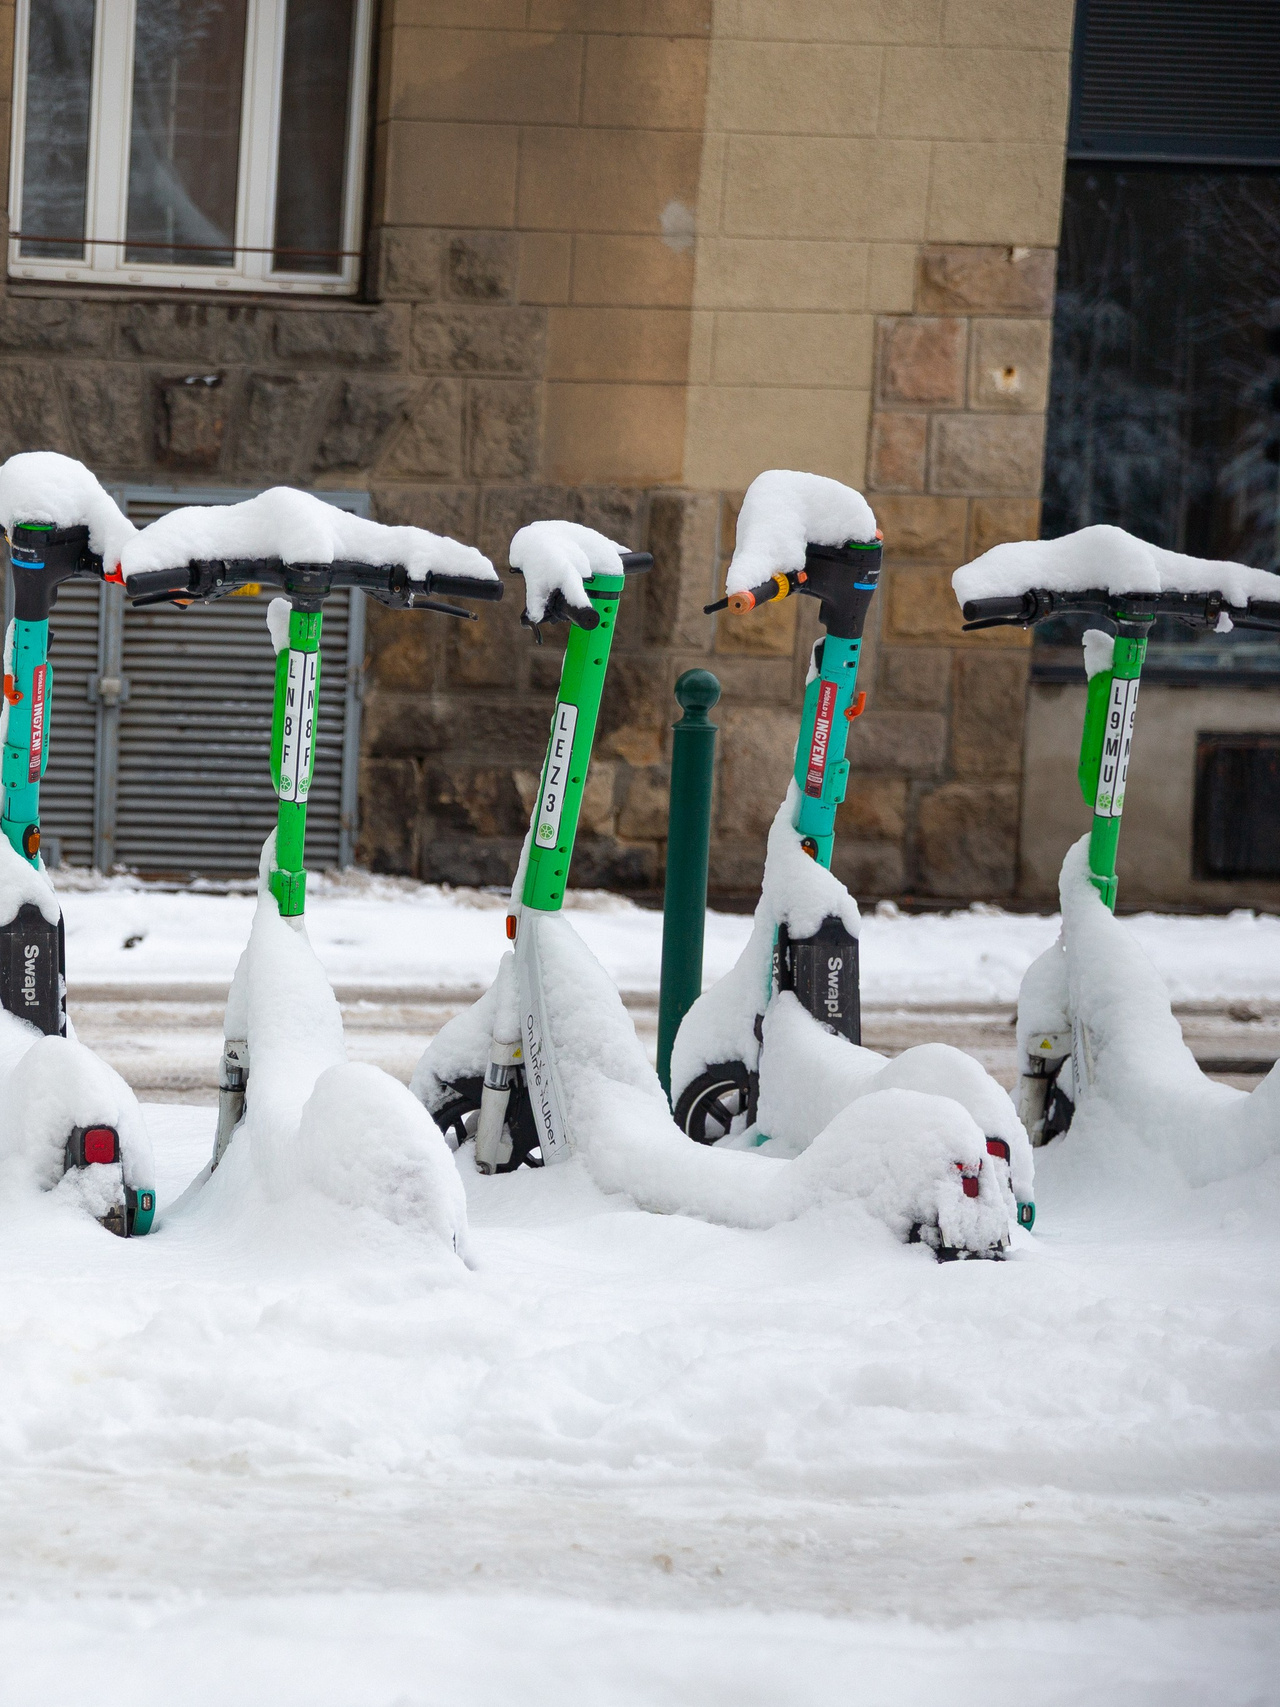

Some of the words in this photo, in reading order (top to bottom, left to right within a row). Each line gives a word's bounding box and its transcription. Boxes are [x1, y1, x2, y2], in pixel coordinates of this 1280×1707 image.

[32, 702, 43, 751] INGYEN!
[283, 658, 295, 764] LN8F
[811, 718, 830, 767] INGYEN!
[1103, 686, 1122, 783] L9MU
[545, 711, 567, 813] LEZ3
[21, 944, 40, 1006] Swap!
[824, 957, 843, 1018] Swap!
[527, 1014, 534, 1043] On
[541, 1101, 557, 1146] Uber
